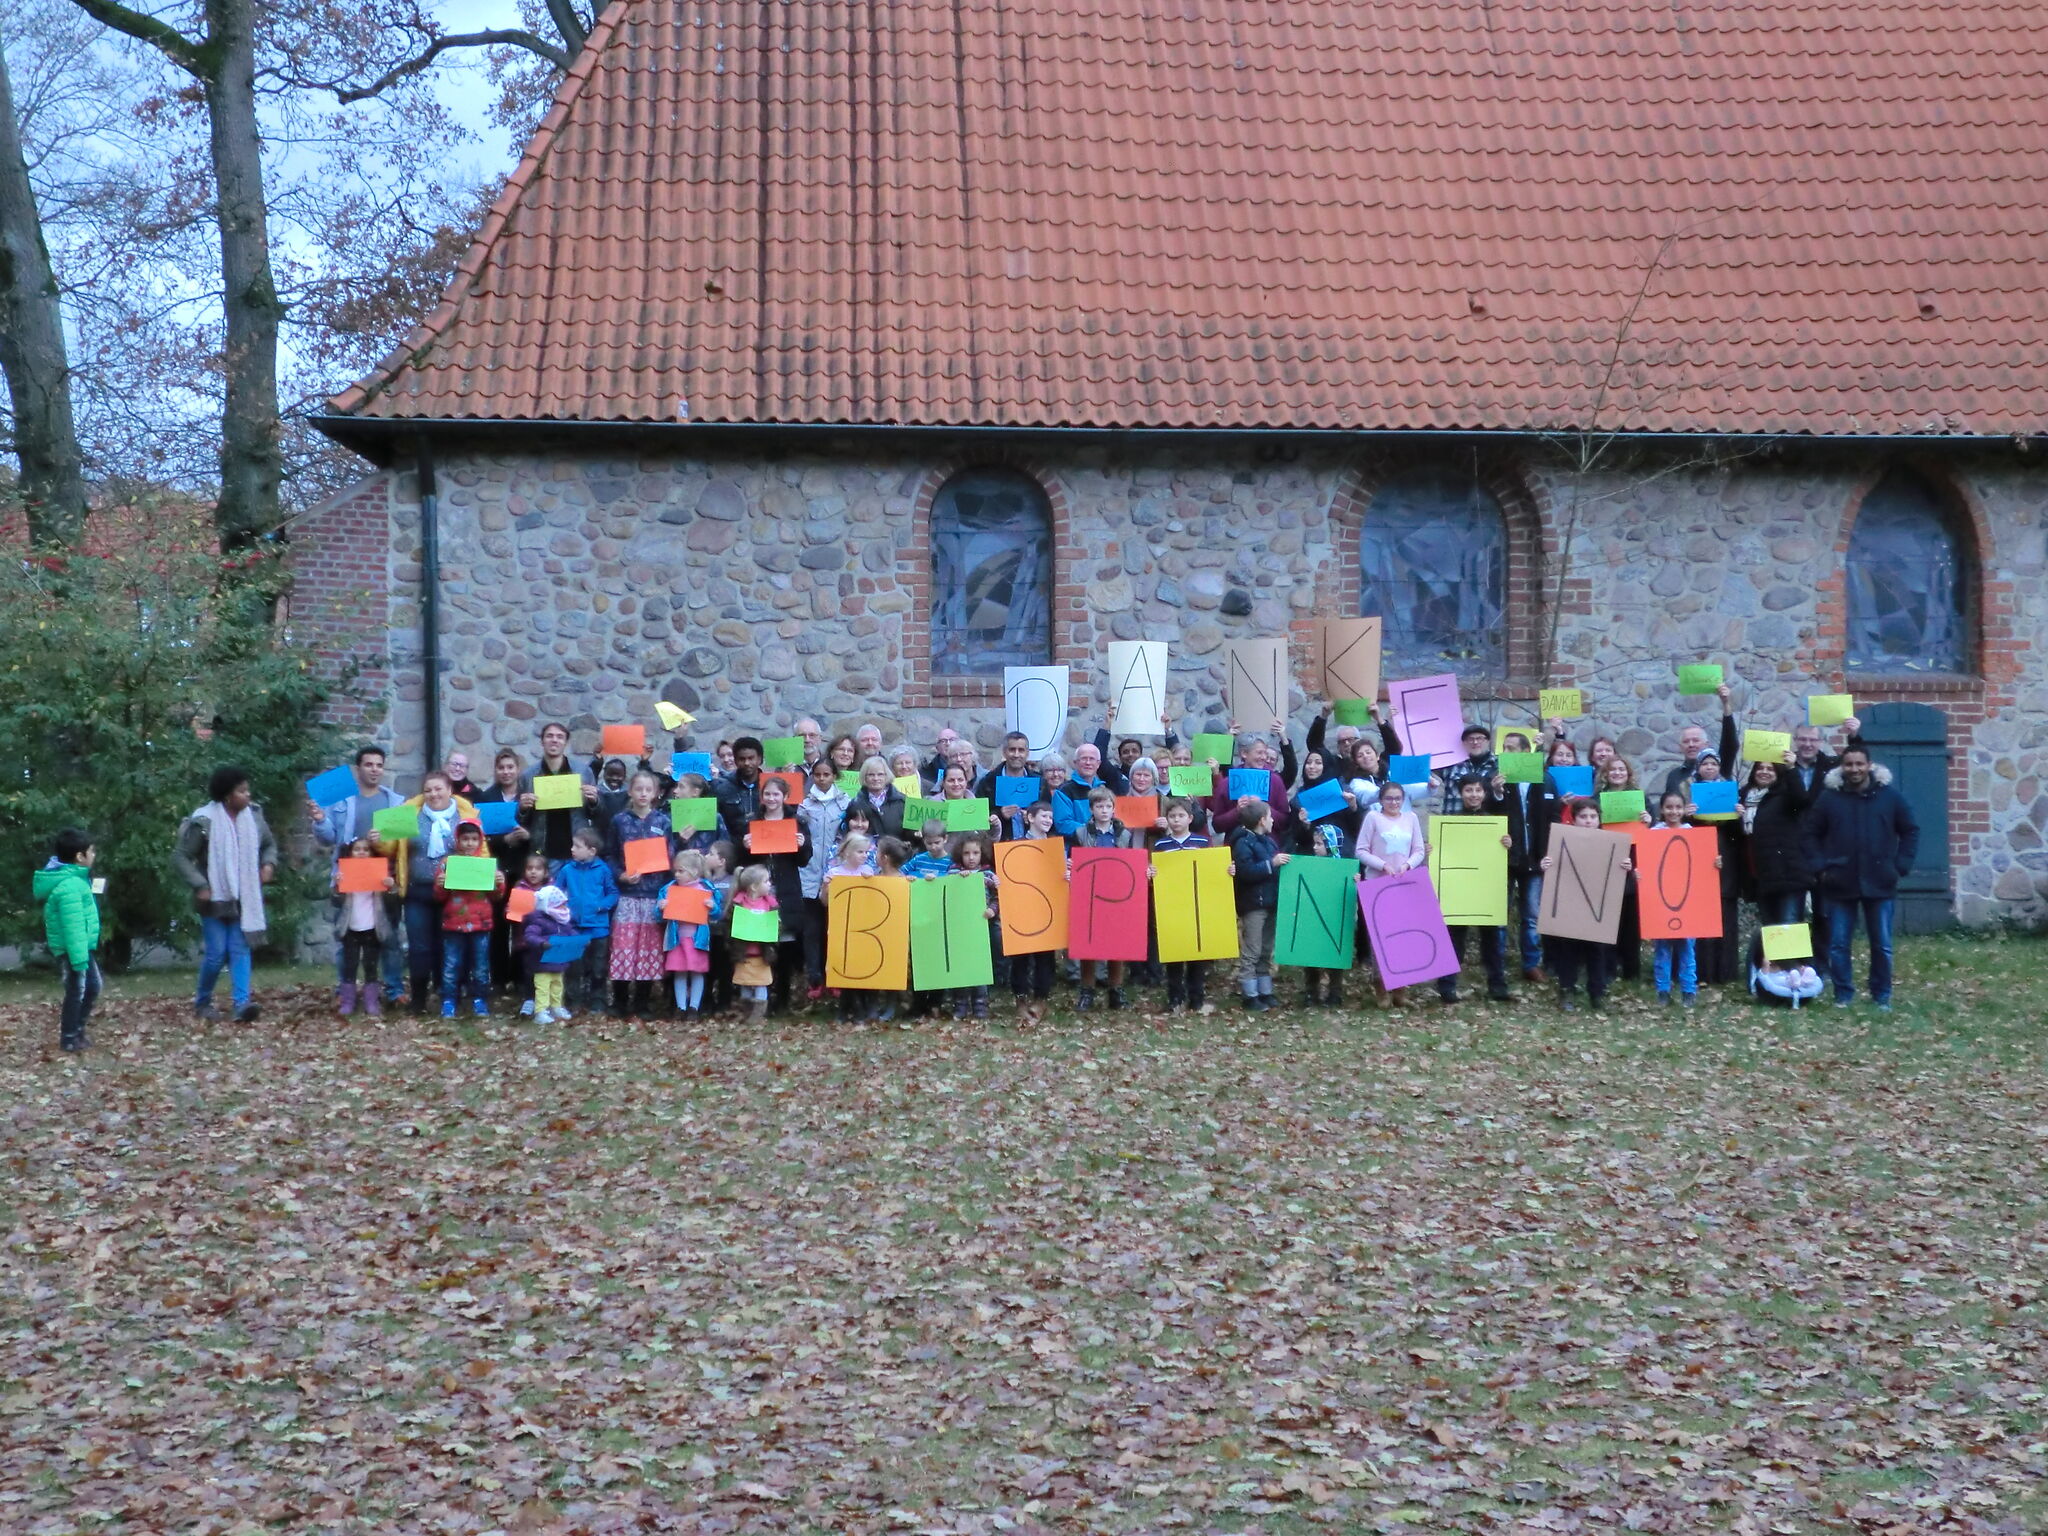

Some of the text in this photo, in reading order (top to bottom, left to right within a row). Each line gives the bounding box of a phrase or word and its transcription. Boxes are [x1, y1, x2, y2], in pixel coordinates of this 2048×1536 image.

[1541, 694, 1579, 711] DANKE
[1231, 772, 1269, 795] DANKE
[909, 804, 947, 822] DANKE
